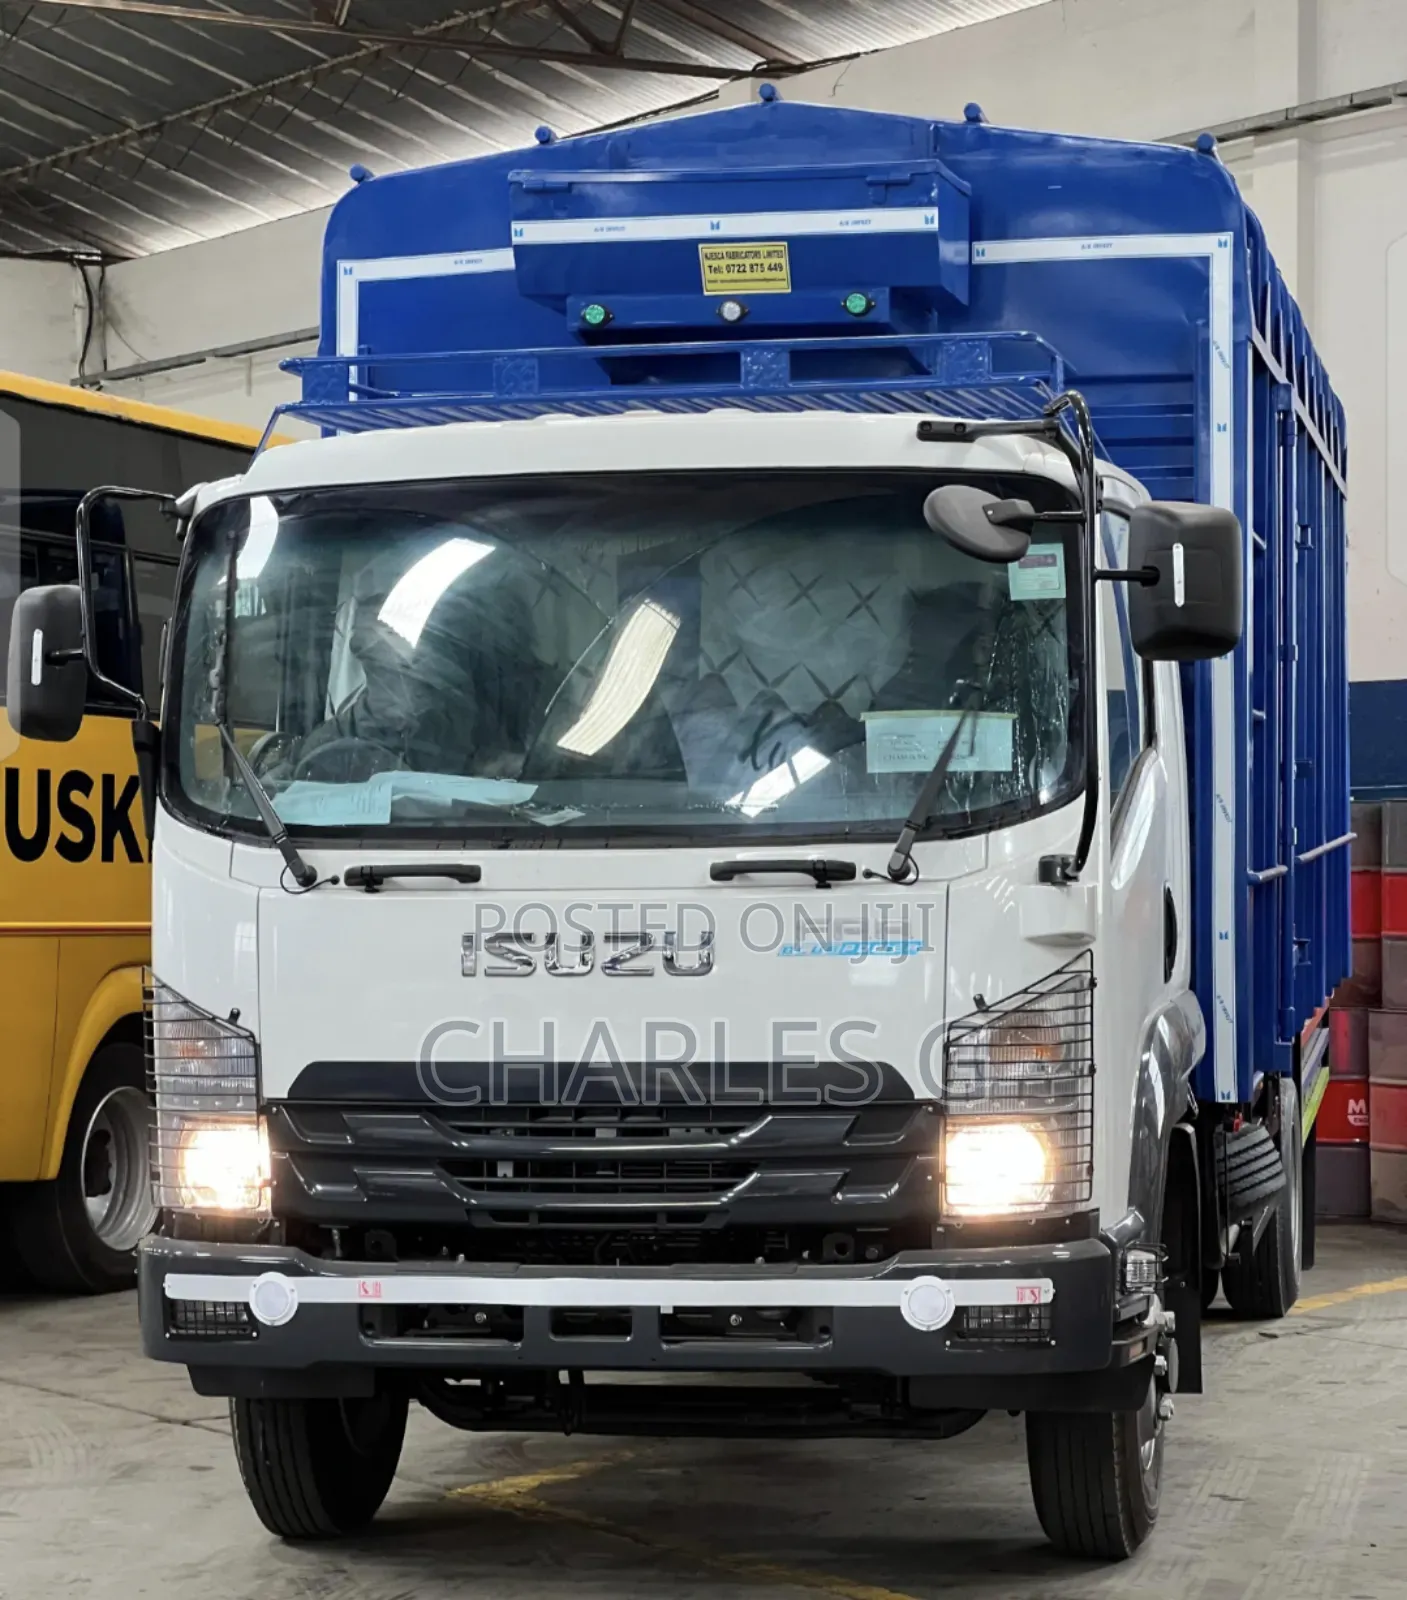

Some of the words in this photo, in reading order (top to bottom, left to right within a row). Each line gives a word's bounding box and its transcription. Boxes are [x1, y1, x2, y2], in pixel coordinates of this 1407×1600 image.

[707, 264, 723, 275] Tel:
[725, 263, 747, 274] 0722
[749, 262, 765, 273] 875
[767, 262, 784, 272] 449
[5, 767, 152, 863] USK
[460, 931, 715, 977] ISUZU
